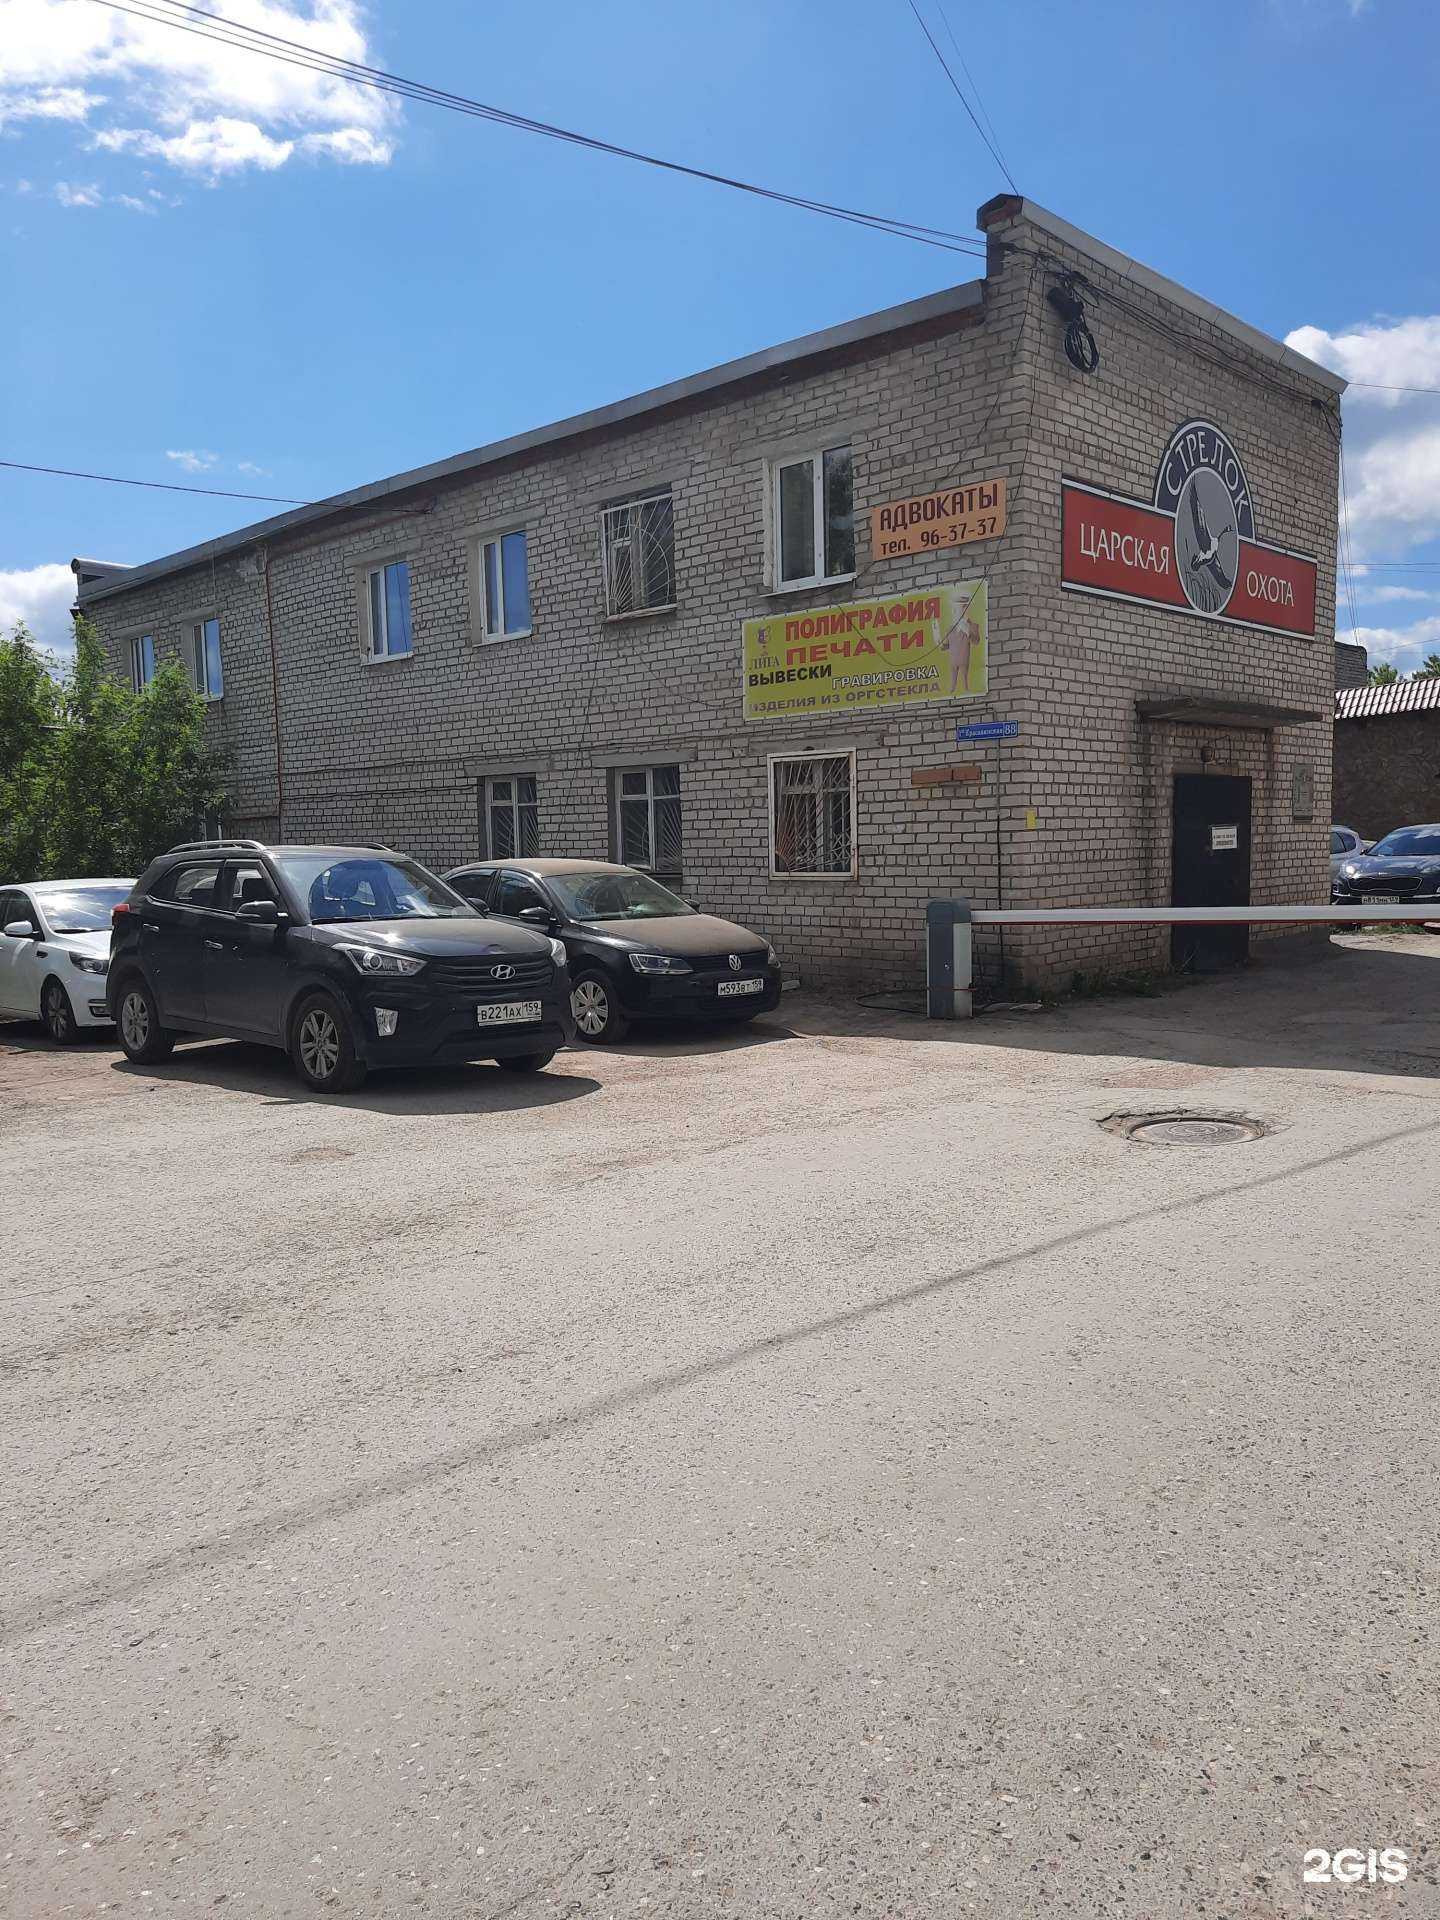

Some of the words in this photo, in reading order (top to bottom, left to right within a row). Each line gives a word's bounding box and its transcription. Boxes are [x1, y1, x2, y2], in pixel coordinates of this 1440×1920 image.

[1165, 431, 1250, 518] СТРЕЛОК
[880, 483, 998, 533] АДВОКАТЫ
[881, 538, 911, 555] тел.
[920, 517, 997, 547] 96-37-37
[1079, 523, 1170, 575] ЦАРСКАЯ
[1246, 571, 1295, 607] ОХОТА
[785, 597, 941, 642] ПОЛИГРАФИЯ
[786, 629, 925, 666] ПЕЧАТИ
[748, 664, 832, 687] ВЫВЕСКИ
[821, 694, 841, 705] ИЗ
[846, 681, 941, 702] ОРГСТЕКЛА
[832, 664, 940, 690] ГРАВИРОВКА
